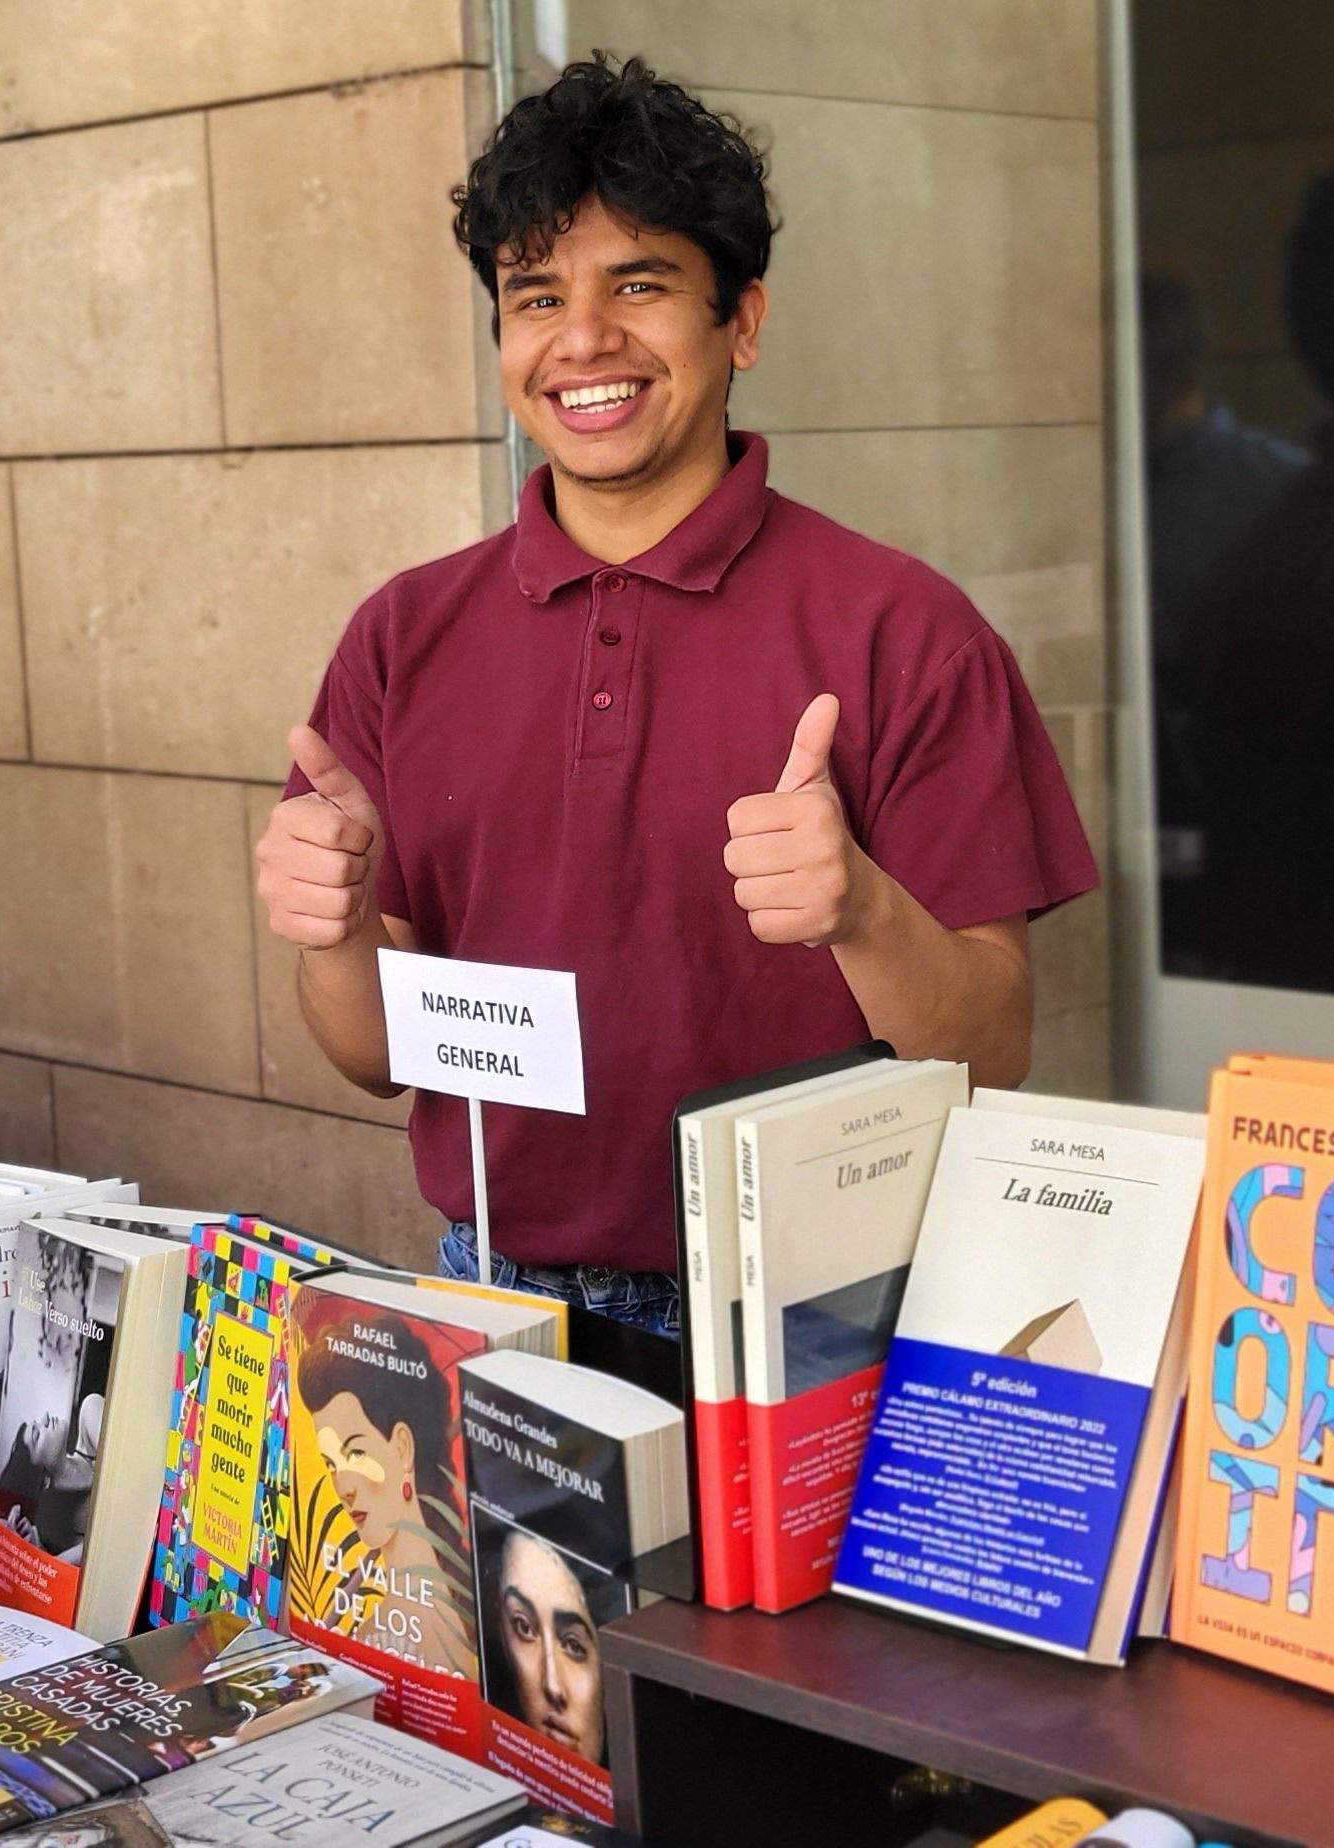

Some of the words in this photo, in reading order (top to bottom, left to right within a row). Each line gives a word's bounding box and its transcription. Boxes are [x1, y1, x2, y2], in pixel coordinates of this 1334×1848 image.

[422, 990, 534, 1028] NARRATIVA
[437, 1043, 524, 1077] GENERAL
[840, 1115, 871, 1136] SARA
[873, 1106, 902, 1126] MESA
[687, 1131, 700, 1186] amor
[741, 1136, 753, 1190] amor
[1030, 1138, 1065, 1156] SARA
[1069, 1144, 1105, 1161] MESA
[837, 1163, 862, 1190] Un
[866, 1150, 913, 1179] amor
[688, 1187, 701, 1218] Un
[741, 1190, 755, 1222] Un
[1001, 1178, 1031, 1203] La
[1033, 1183, 1114, 1216] familia
[694, 1250, 703, 1282] MESA
[745, 1254, 756, 1287] MESA
[45, 1299, 68, 1329] Verso
[70, 1316, 105, 1342] suelto
[354, 1322, 397, 1350] RAFAEL
[217, 1335, 233, 1360] Se
[233, 1345, 265, 1377] tiene
[326, 1337, 385, 1368] TARRADAS
[387, 1355, 428, 1380] BULTÓ
[226, 1371, 249, 1397] que
[987, 1376, 1038, 1399] edición
[217, 1397, 253, 1429] morir
[463, 1389, 512, 1428] Almudena
[513, 1412, 559, 1449] Grandes
[903, 1382, 939, 1400] PREMIO
[940, 1387, 985, 1409] CÁLAMO
[985, 1396, 1078, 1429] EXTRAORDINARIO
[1078, 1419, 1107, 1435] 2022
[211, 1422, 252, 1459] mucha
[211, 1451, 245, 1484] gente
[465, 1418, 502, 1452] TODO
[503, 1438, 522, 1466] VA
[523, 1448, 535, 1471] A
[535, 1452, 606, 1504] MEJORAR
[203, 1502, 243, 1539] VICTORIA
[203, 1524, 238, 1556] MARTÍN
[323, 1544, 351, 1579] EL
[359, 1558, 435, 1609] VALLE
[872, 1562, 907, 1583] SEGÚN
[907, 1571, 929, 1589] LOS
[929, 1577, 970, 1600] MEDIOS
[970, 1586, 1042, 1619] CULTURALES
[884, 1549, 899, 1564] DE
[899, 1553, 921, 1569] LOS
[921, 1558, 971, 1583] MEJORES
[971, 1571, 1012, 1594] LIBROS
[1012, 1581, 1034, 1598] DEL
[1035, 1589, 1062, 1608] AÑO
[1, 1622, 54, 1648] TRENZA
[334, 1587, 364, 1617] DE
[374, 1607, 423, 1645] LOS
[1263, 1634, 1304, 1657] ESPACIO
[11, 1675, 122, 1732] CASADAS
[40, 1664, 86, 1684] DE
[77, 1679, 184, 1737] MUJERES
[318, 1758, 381, 1788] PONSETI
[355, 1750, 422, 1789] ANTONIO
[221, 1752, 289, 1785] LA
[285, 1777, 398, 1834] CAJA
[190, 1784, 313, 1841] AZUL
